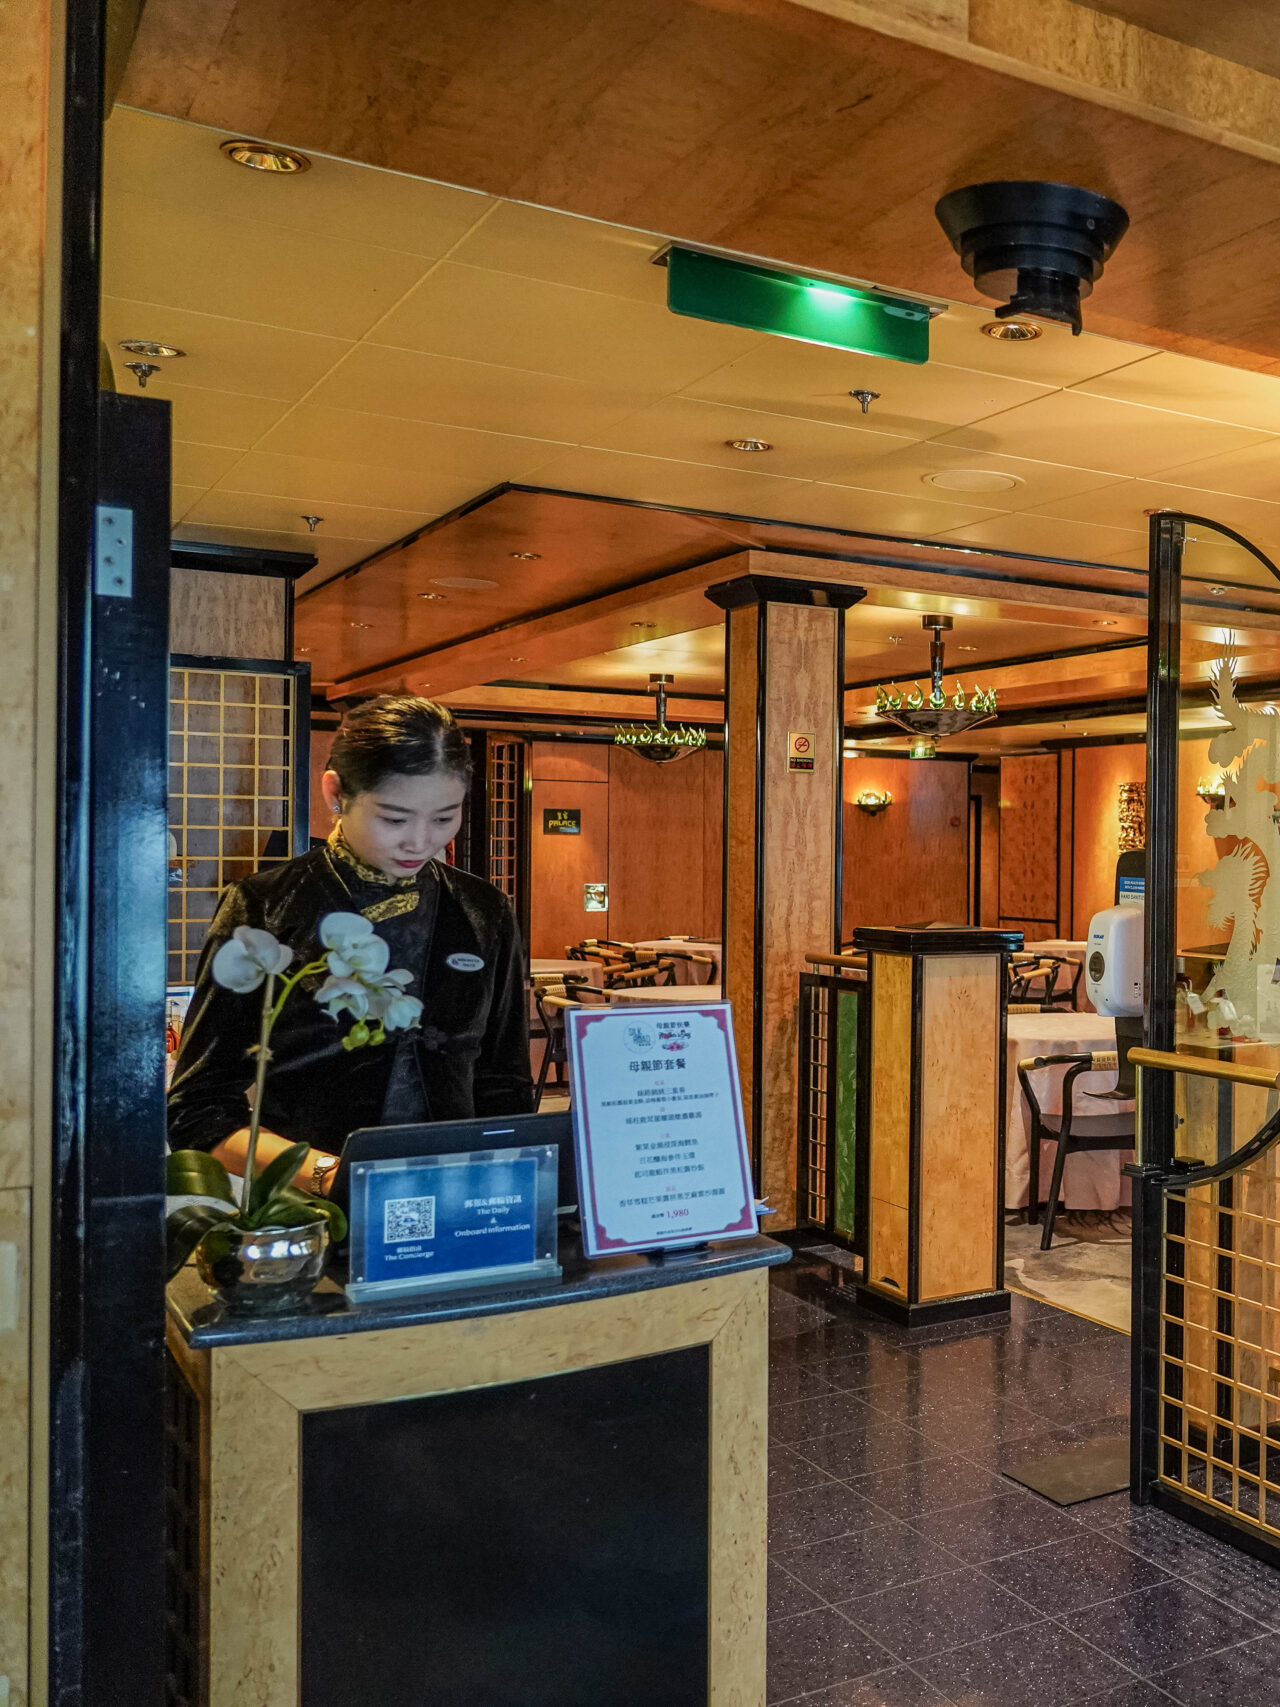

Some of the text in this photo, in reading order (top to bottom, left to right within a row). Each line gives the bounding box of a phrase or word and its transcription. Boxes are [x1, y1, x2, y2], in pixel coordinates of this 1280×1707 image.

[548, 820, 576, 829] PALACE
[629, 1057, 687, 1073] 母親節套餐
[491, 1206, 510, 1215] Daily
[666, 1208, 689, 1220] 1,980
[490, 1216, 497, 1224] &
[454, 1227, 487, 1238] Onboard
[398, 1250, 434, 1260] Concierge
